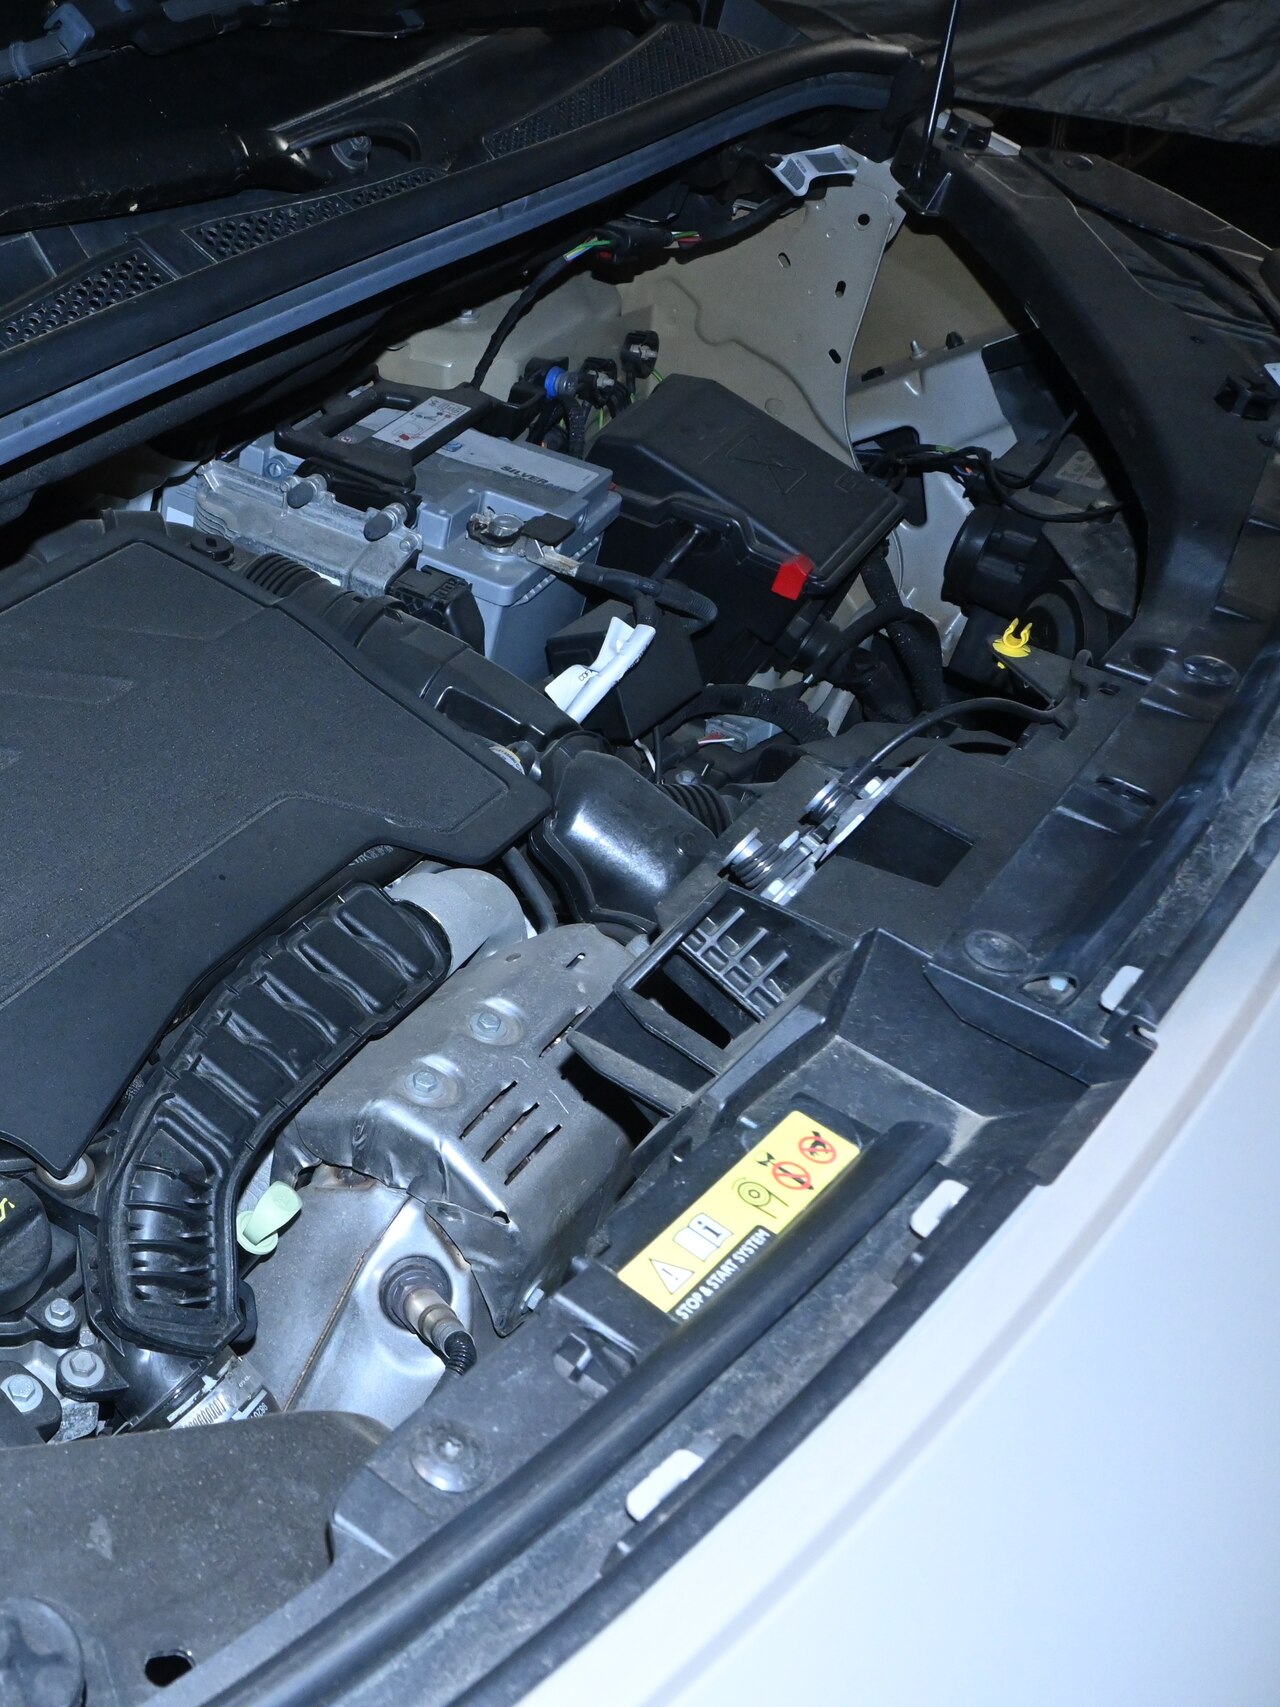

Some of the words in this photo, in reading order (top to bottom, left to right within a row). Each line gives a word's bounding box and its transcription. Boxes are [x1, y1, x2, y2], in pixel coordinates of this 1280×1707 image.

[500, 465, 549, 485] SILVER
[732, 1228, 771, 1264] SYSTEM
[705, 1258, 739, 1290] START
[675, 1291, 704, 1320] STOP
[699, 1285, 714, 1297] &
